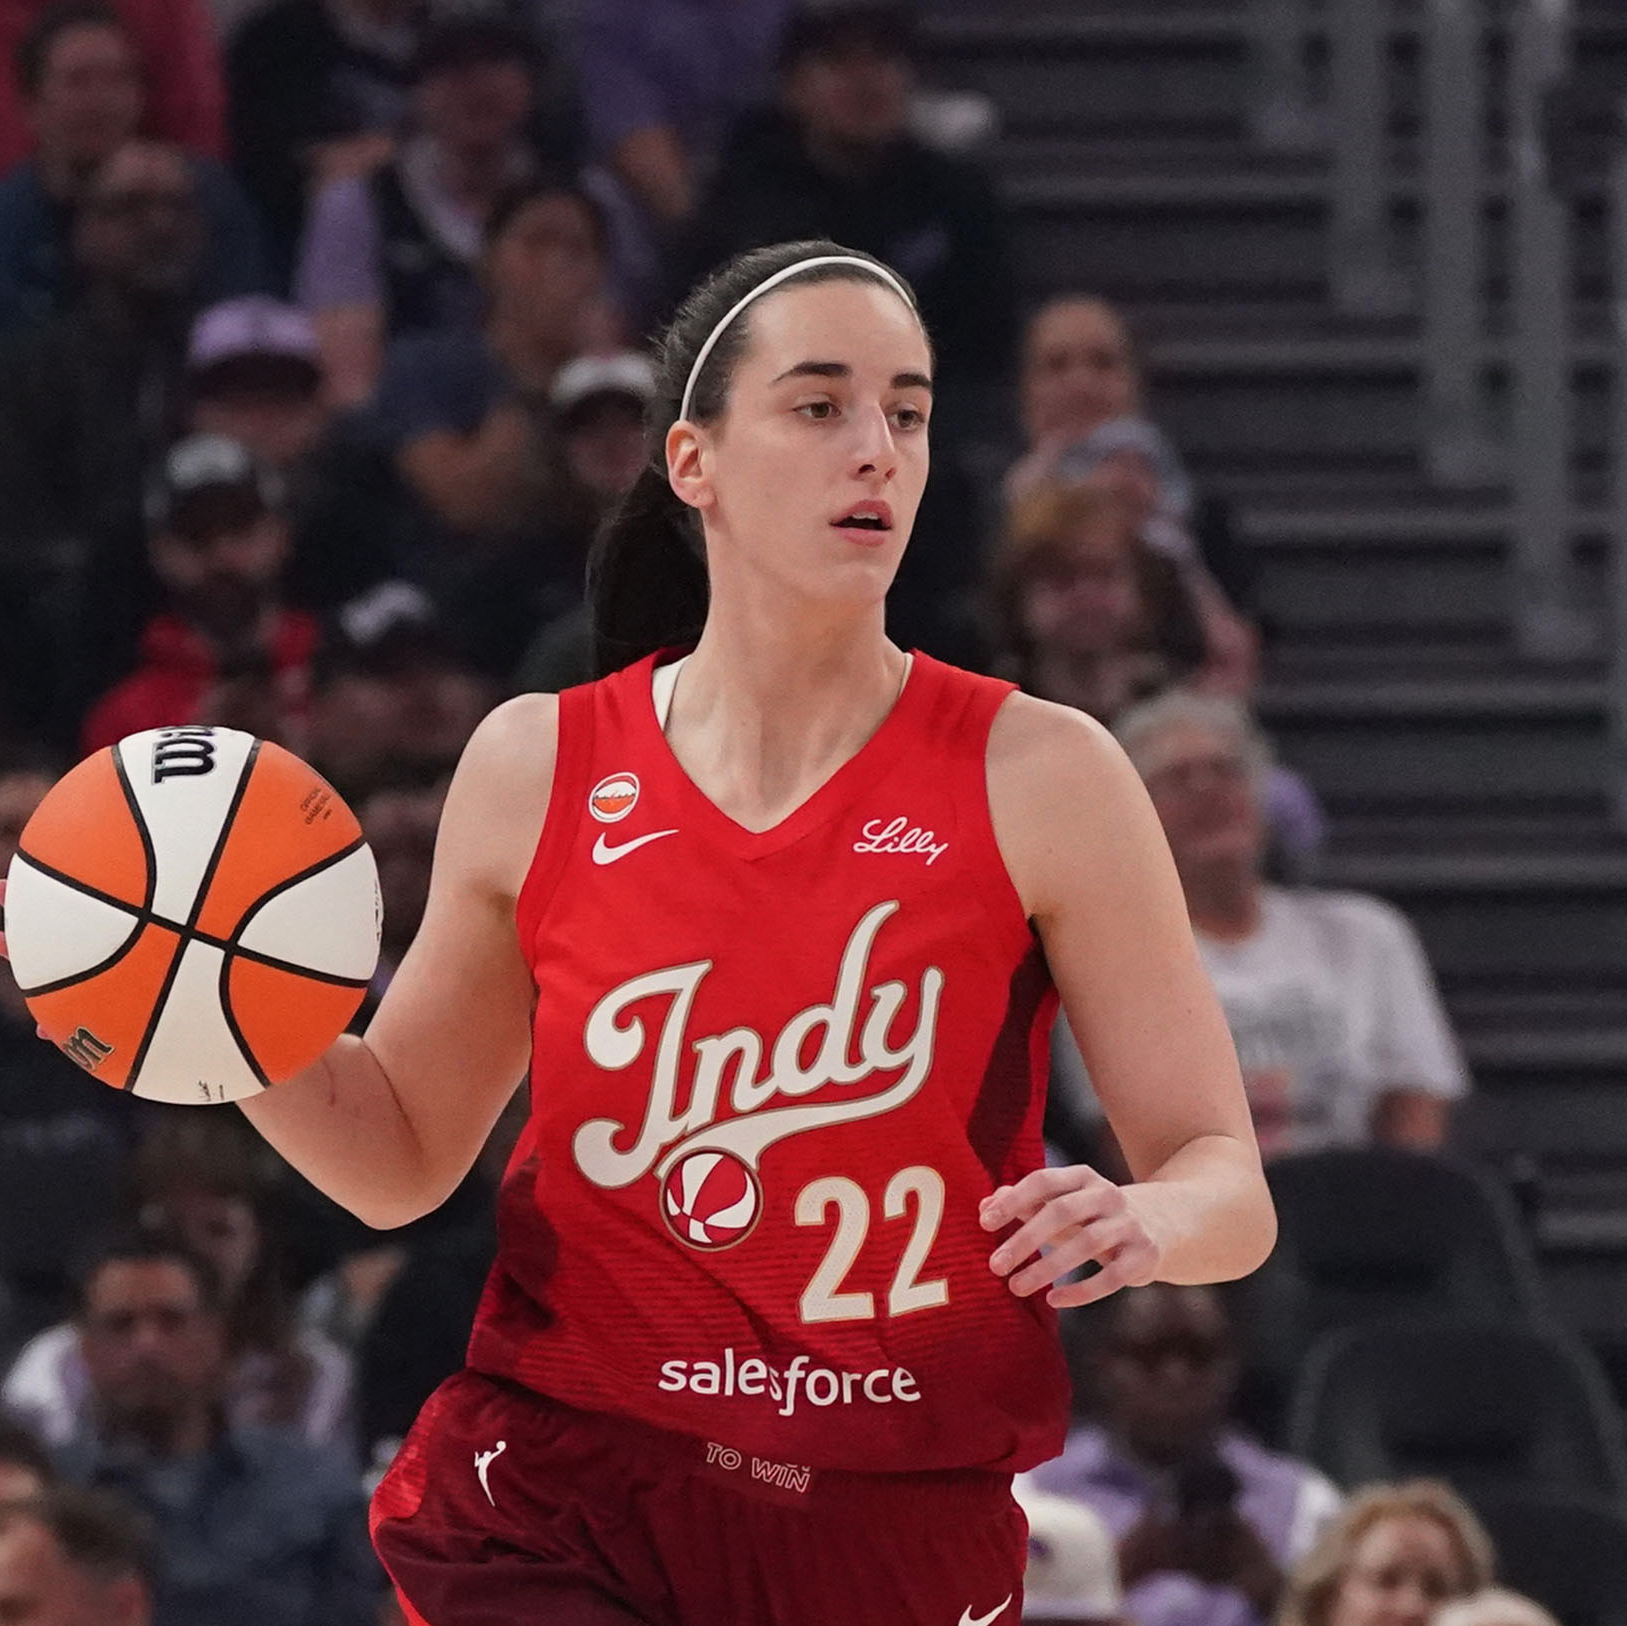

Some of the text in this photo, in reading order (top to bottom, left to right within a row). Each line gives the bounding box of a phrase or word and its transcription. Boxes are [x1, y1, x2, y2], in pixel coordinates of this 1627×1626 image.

[853, 816, 948, 865] Lilly
[573, 899, 944, 1188] Indy
[793, 1165, 949, 1324] 22
[658, 1347, 921, 1416] salesforce
[706, 1441, 811, 1493] TO WIN
